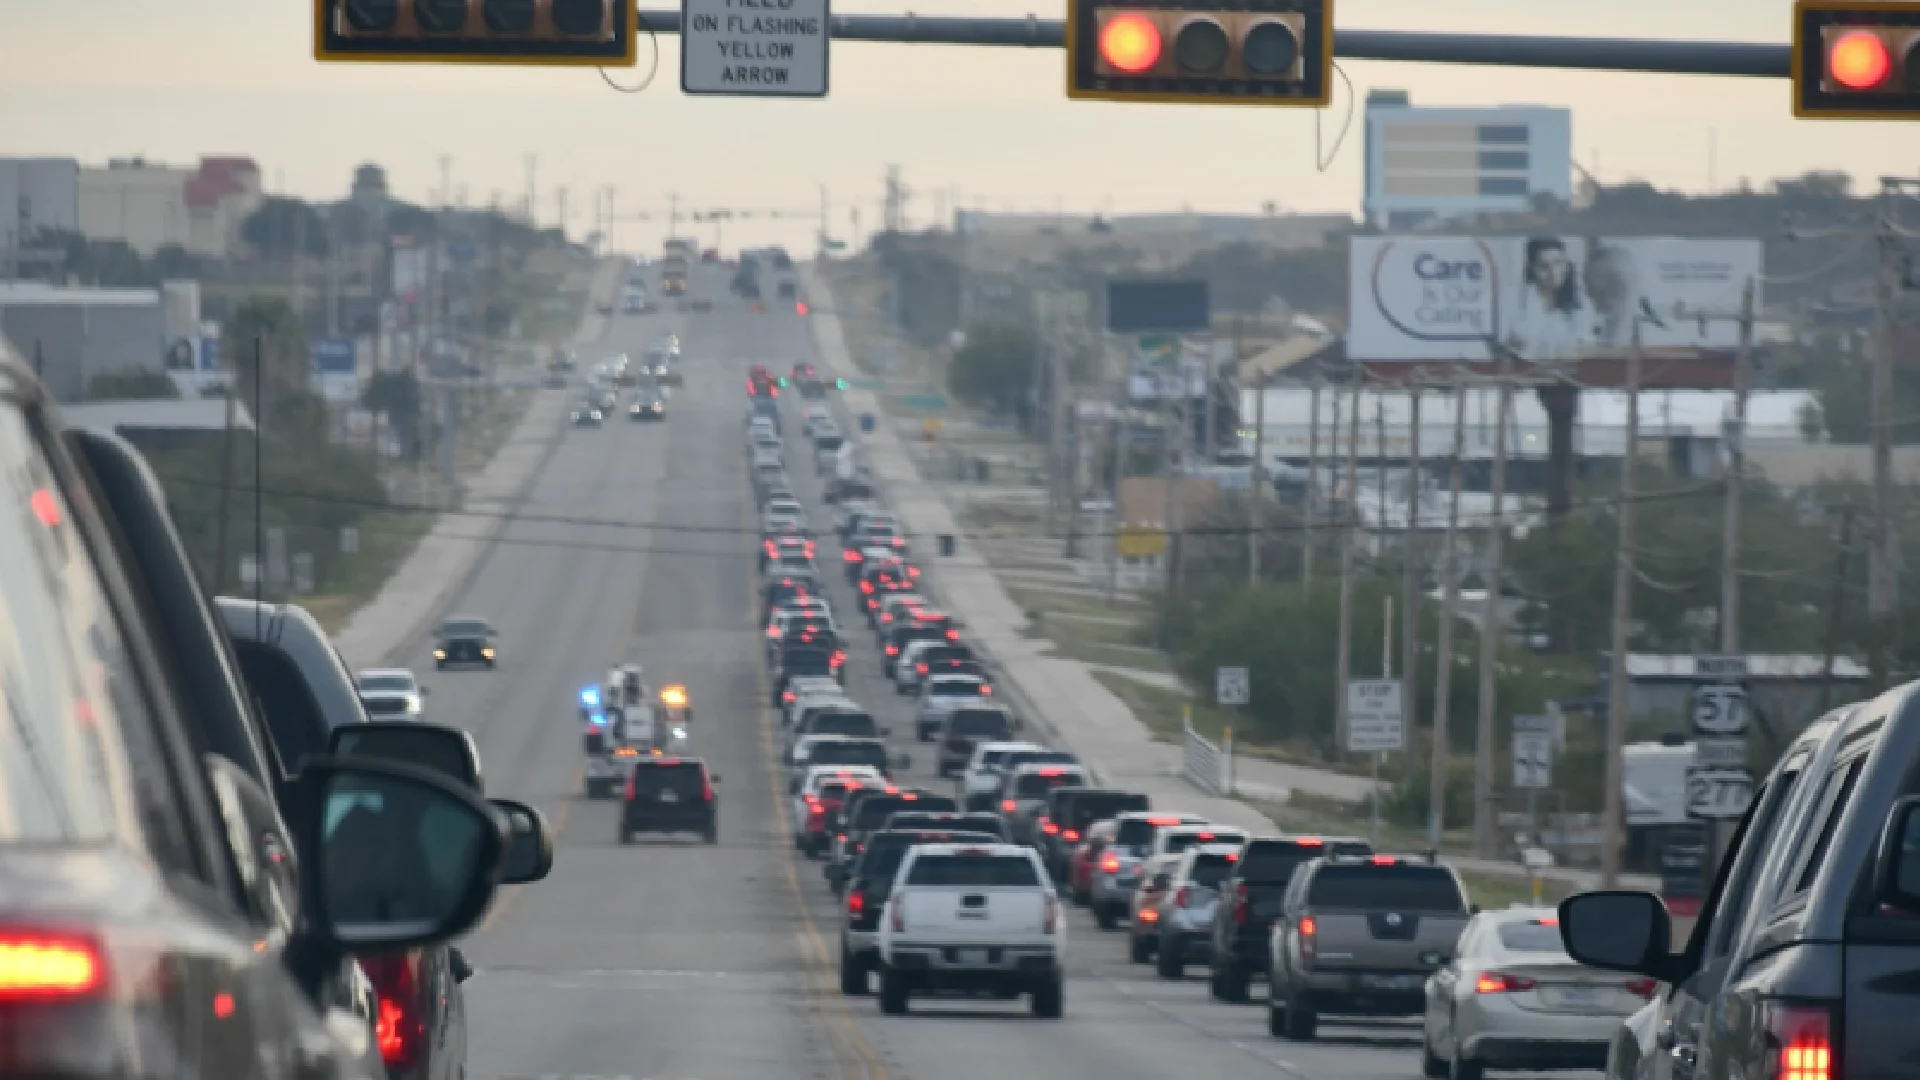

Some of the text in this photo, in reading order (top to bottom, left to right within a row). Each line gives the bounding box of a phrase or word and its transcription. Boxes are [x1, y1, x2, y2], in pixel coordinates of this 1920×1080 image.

[693, 14, 818, 35] ON FLASHING
[717, 40, 794, 58] YELLOW
[721, 66, 789, 84] ARROW
[1413, 252, 1482, 280] Care
[1414, 306, 1482, 329] Calling
[1702, 692, 1742, 721] 57
[1690, 780, 1753, 806] 277
